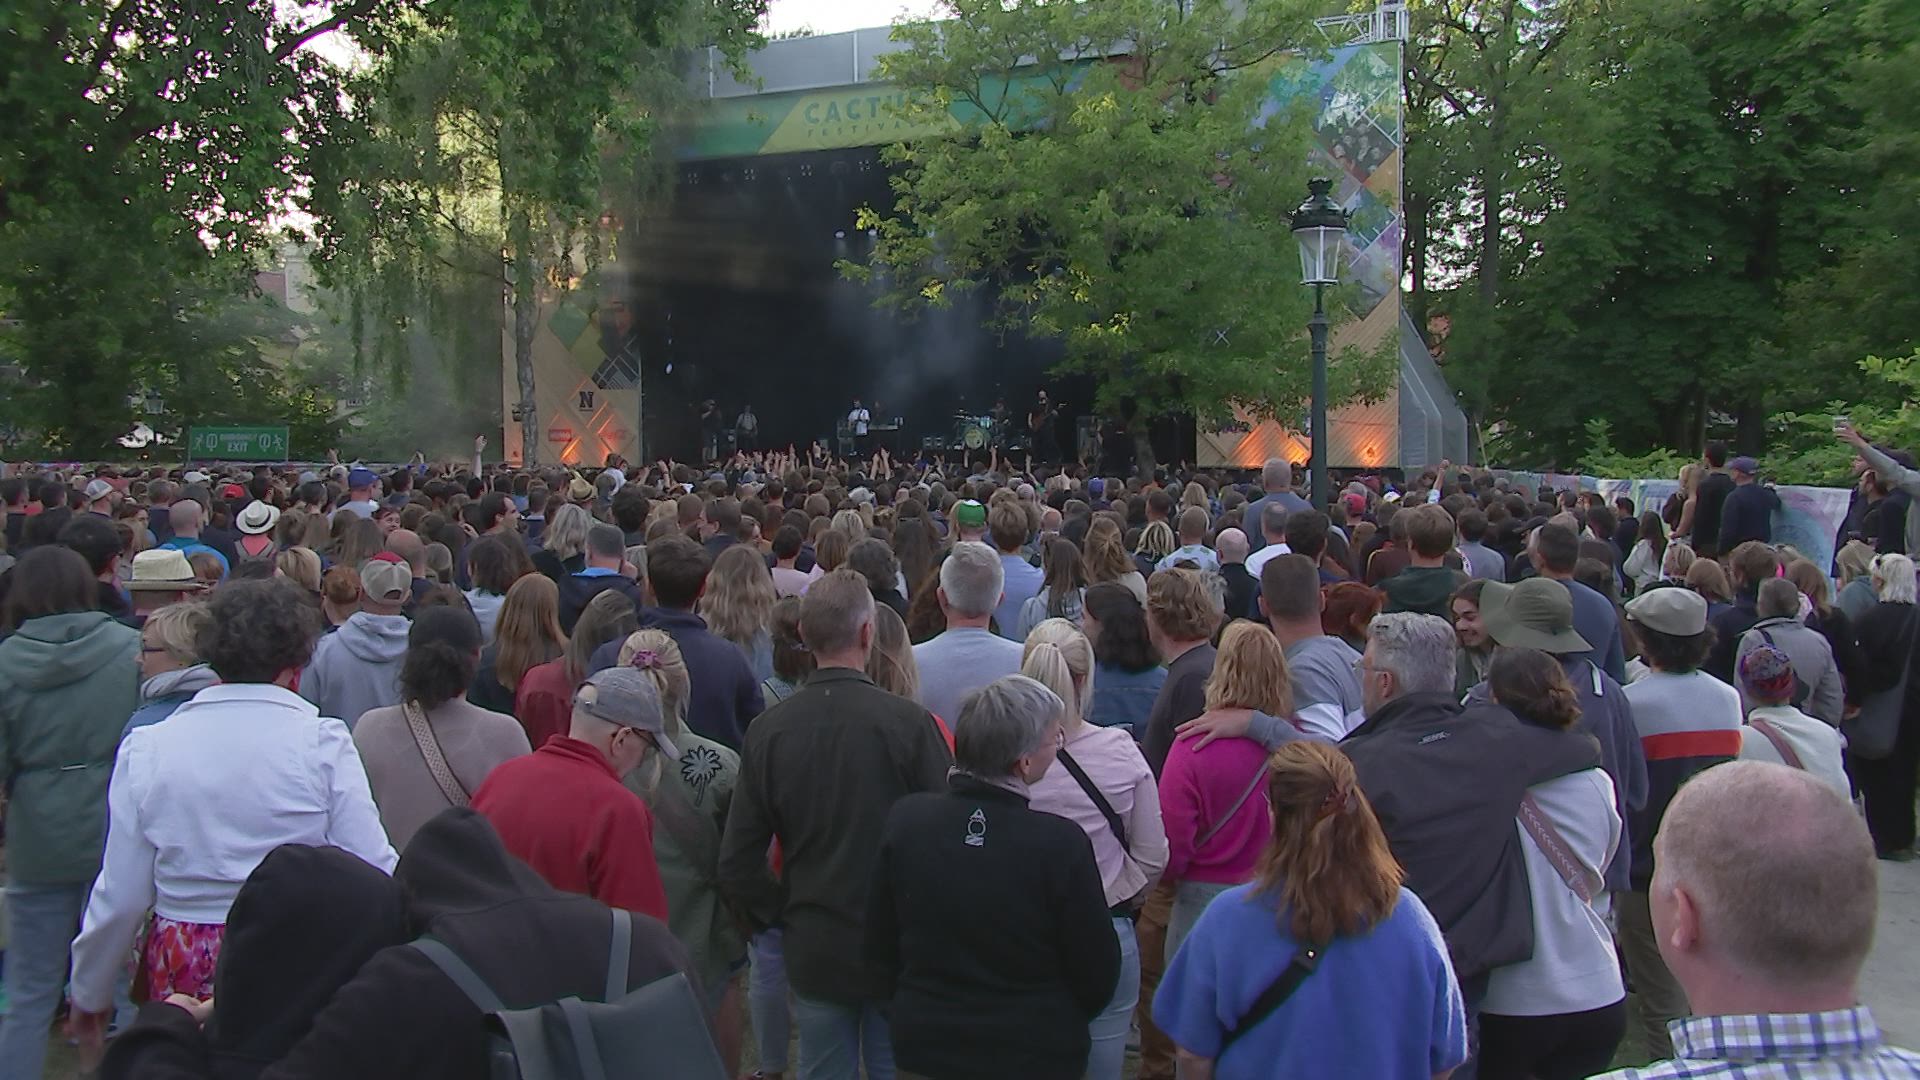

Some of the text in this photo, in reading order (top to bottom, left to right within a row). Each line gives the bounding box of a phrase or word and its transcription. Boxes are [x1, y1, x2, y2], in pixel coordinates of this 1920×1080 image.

[804, 94, 912, 124] CACT
[579, 391, 594, 408] N
[227, 441, 248, 452] EXIT
